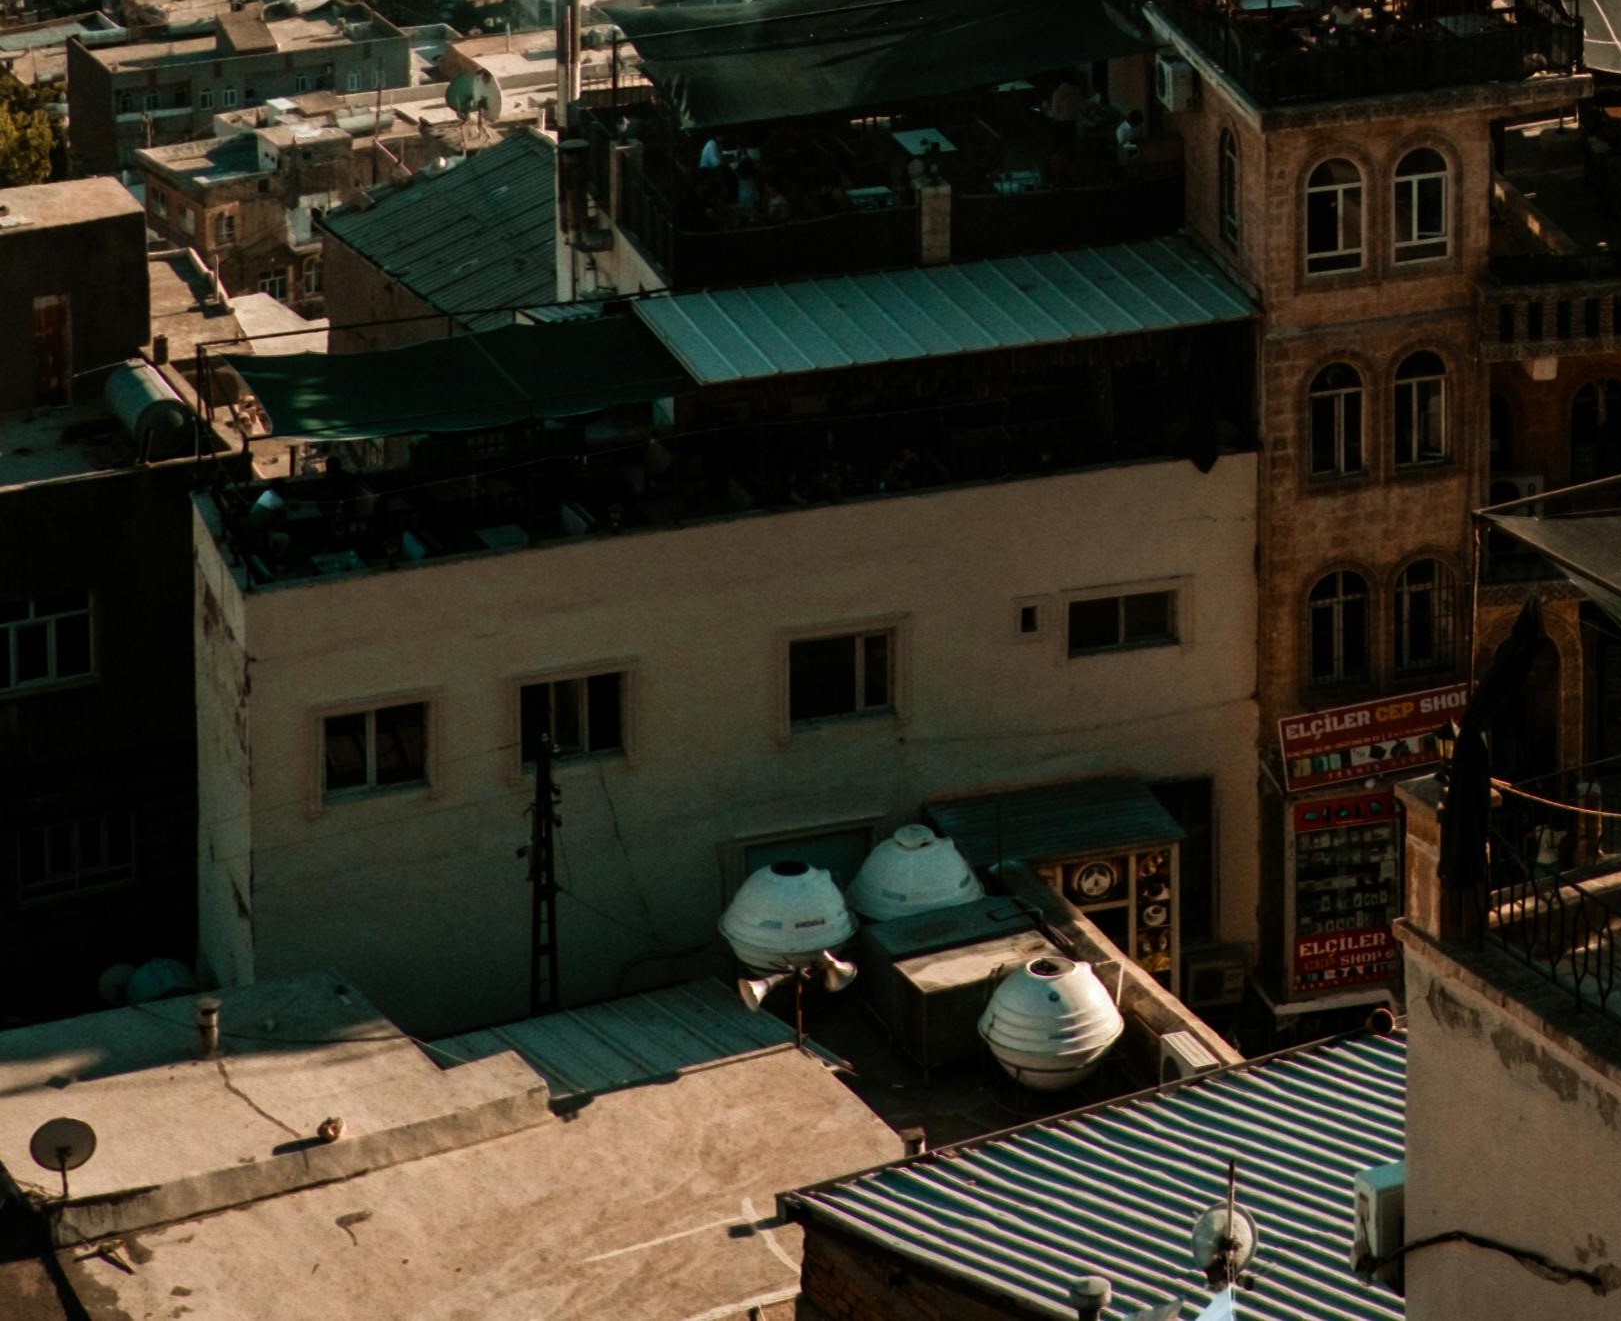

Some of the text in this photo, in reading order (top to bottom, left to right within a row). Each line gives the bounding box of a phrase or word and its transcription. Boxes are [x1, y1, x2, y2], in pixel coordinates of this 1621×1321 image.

[1285, 709, 1371, 740] ELÇİLER
[1375, 701, 1415, 722] CEP
[1299, 932, 1386, 957] ELÇİLER
[1339, 950, 1382, 967] SHOP
